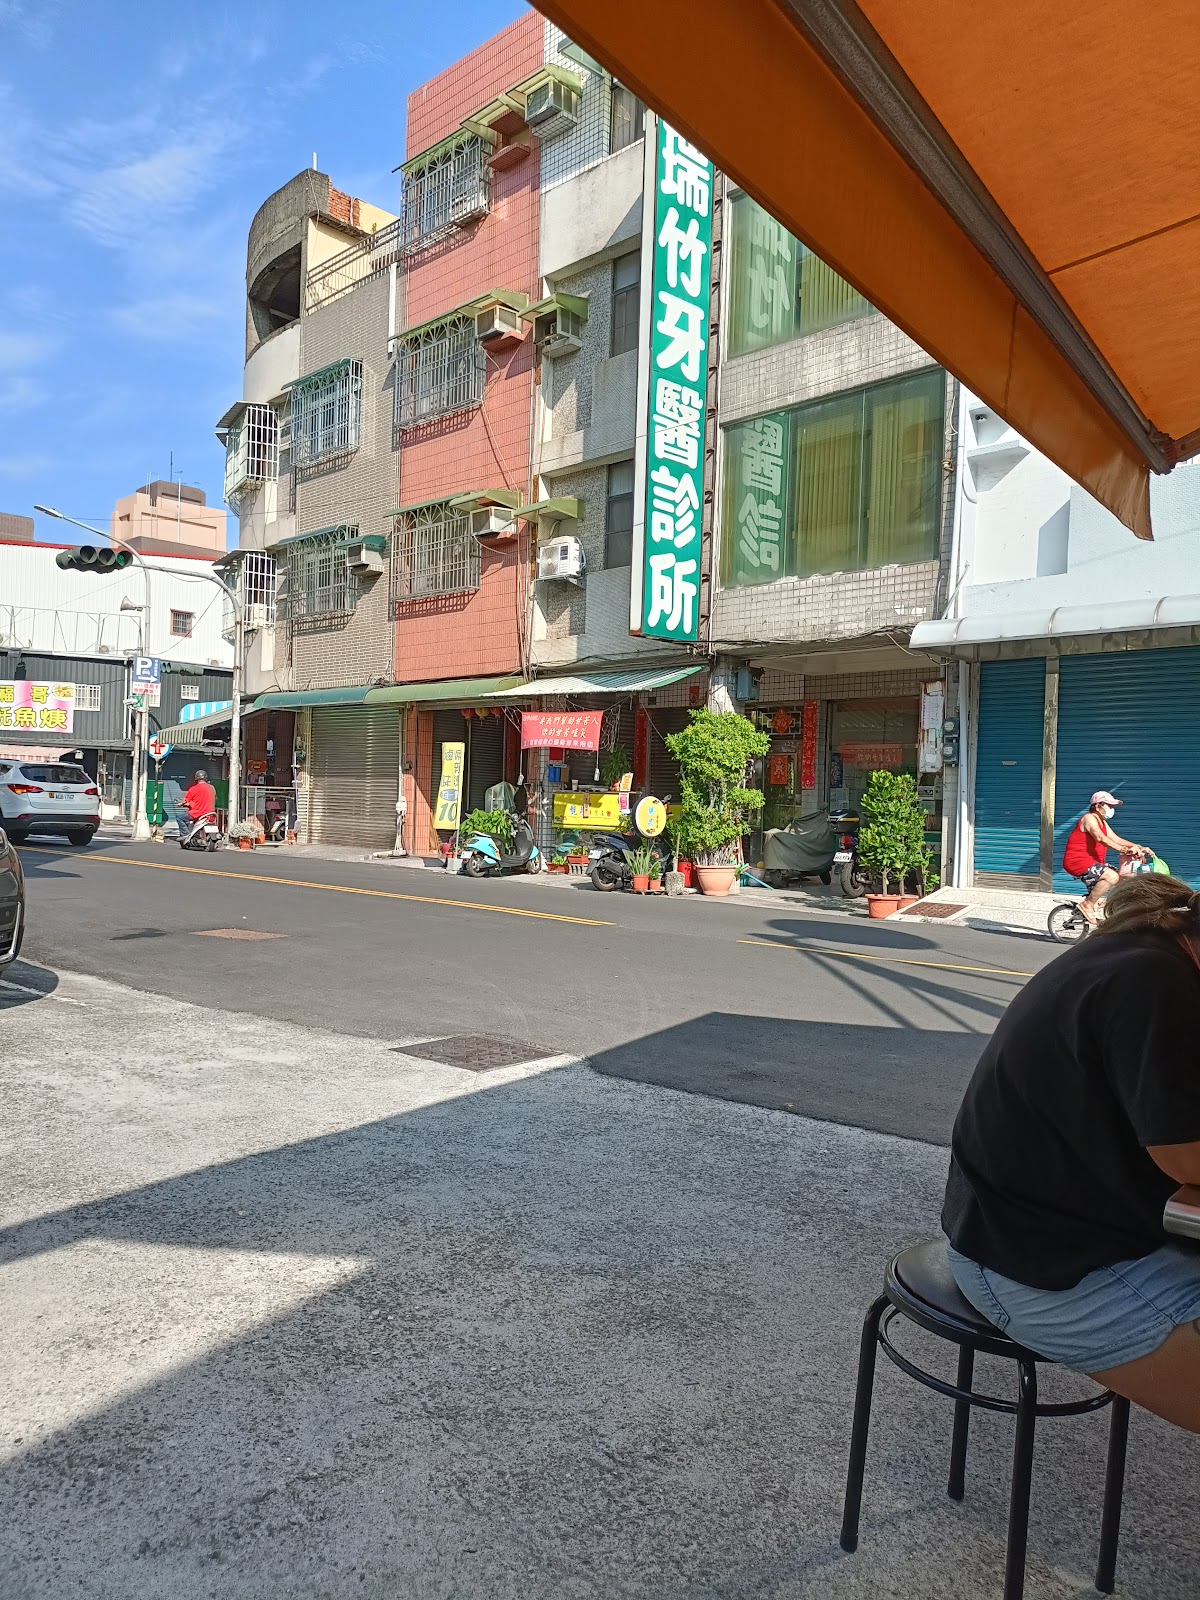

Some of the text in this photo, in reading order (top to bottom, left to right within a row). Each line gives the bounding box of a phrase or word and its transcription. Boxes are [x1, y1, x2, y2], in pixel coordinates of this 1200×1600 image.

[648, 121, 710, 634] 瑞竹牙醫診所
[136, 657, 152, 675] P
